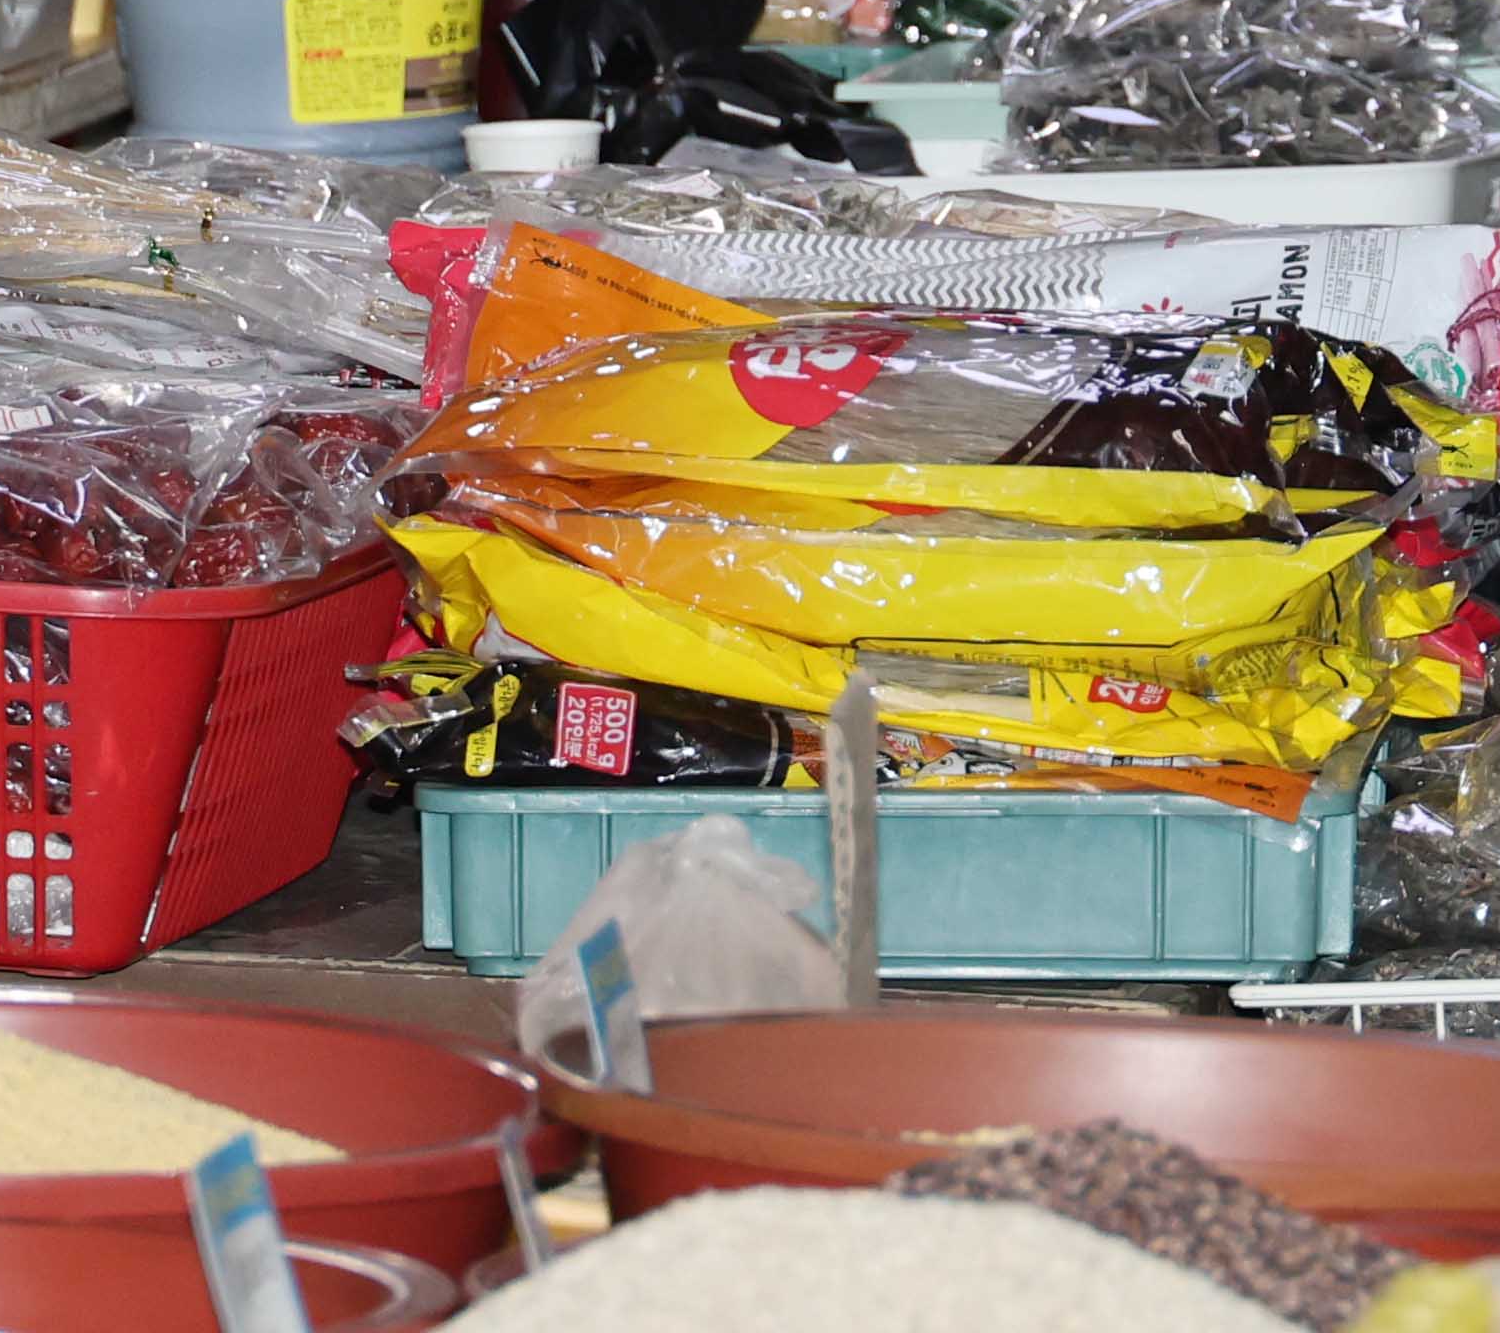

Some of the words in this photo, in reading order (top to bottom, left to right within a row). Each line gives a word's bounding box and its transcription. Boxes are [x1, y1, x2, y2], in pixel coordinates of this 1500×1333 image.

[1274, 244, 1312, 325] AMON
[564, 695, 587, 758] 20인분
[604, 697, 629, 744] 500
[598, 753, 616, 769] g
